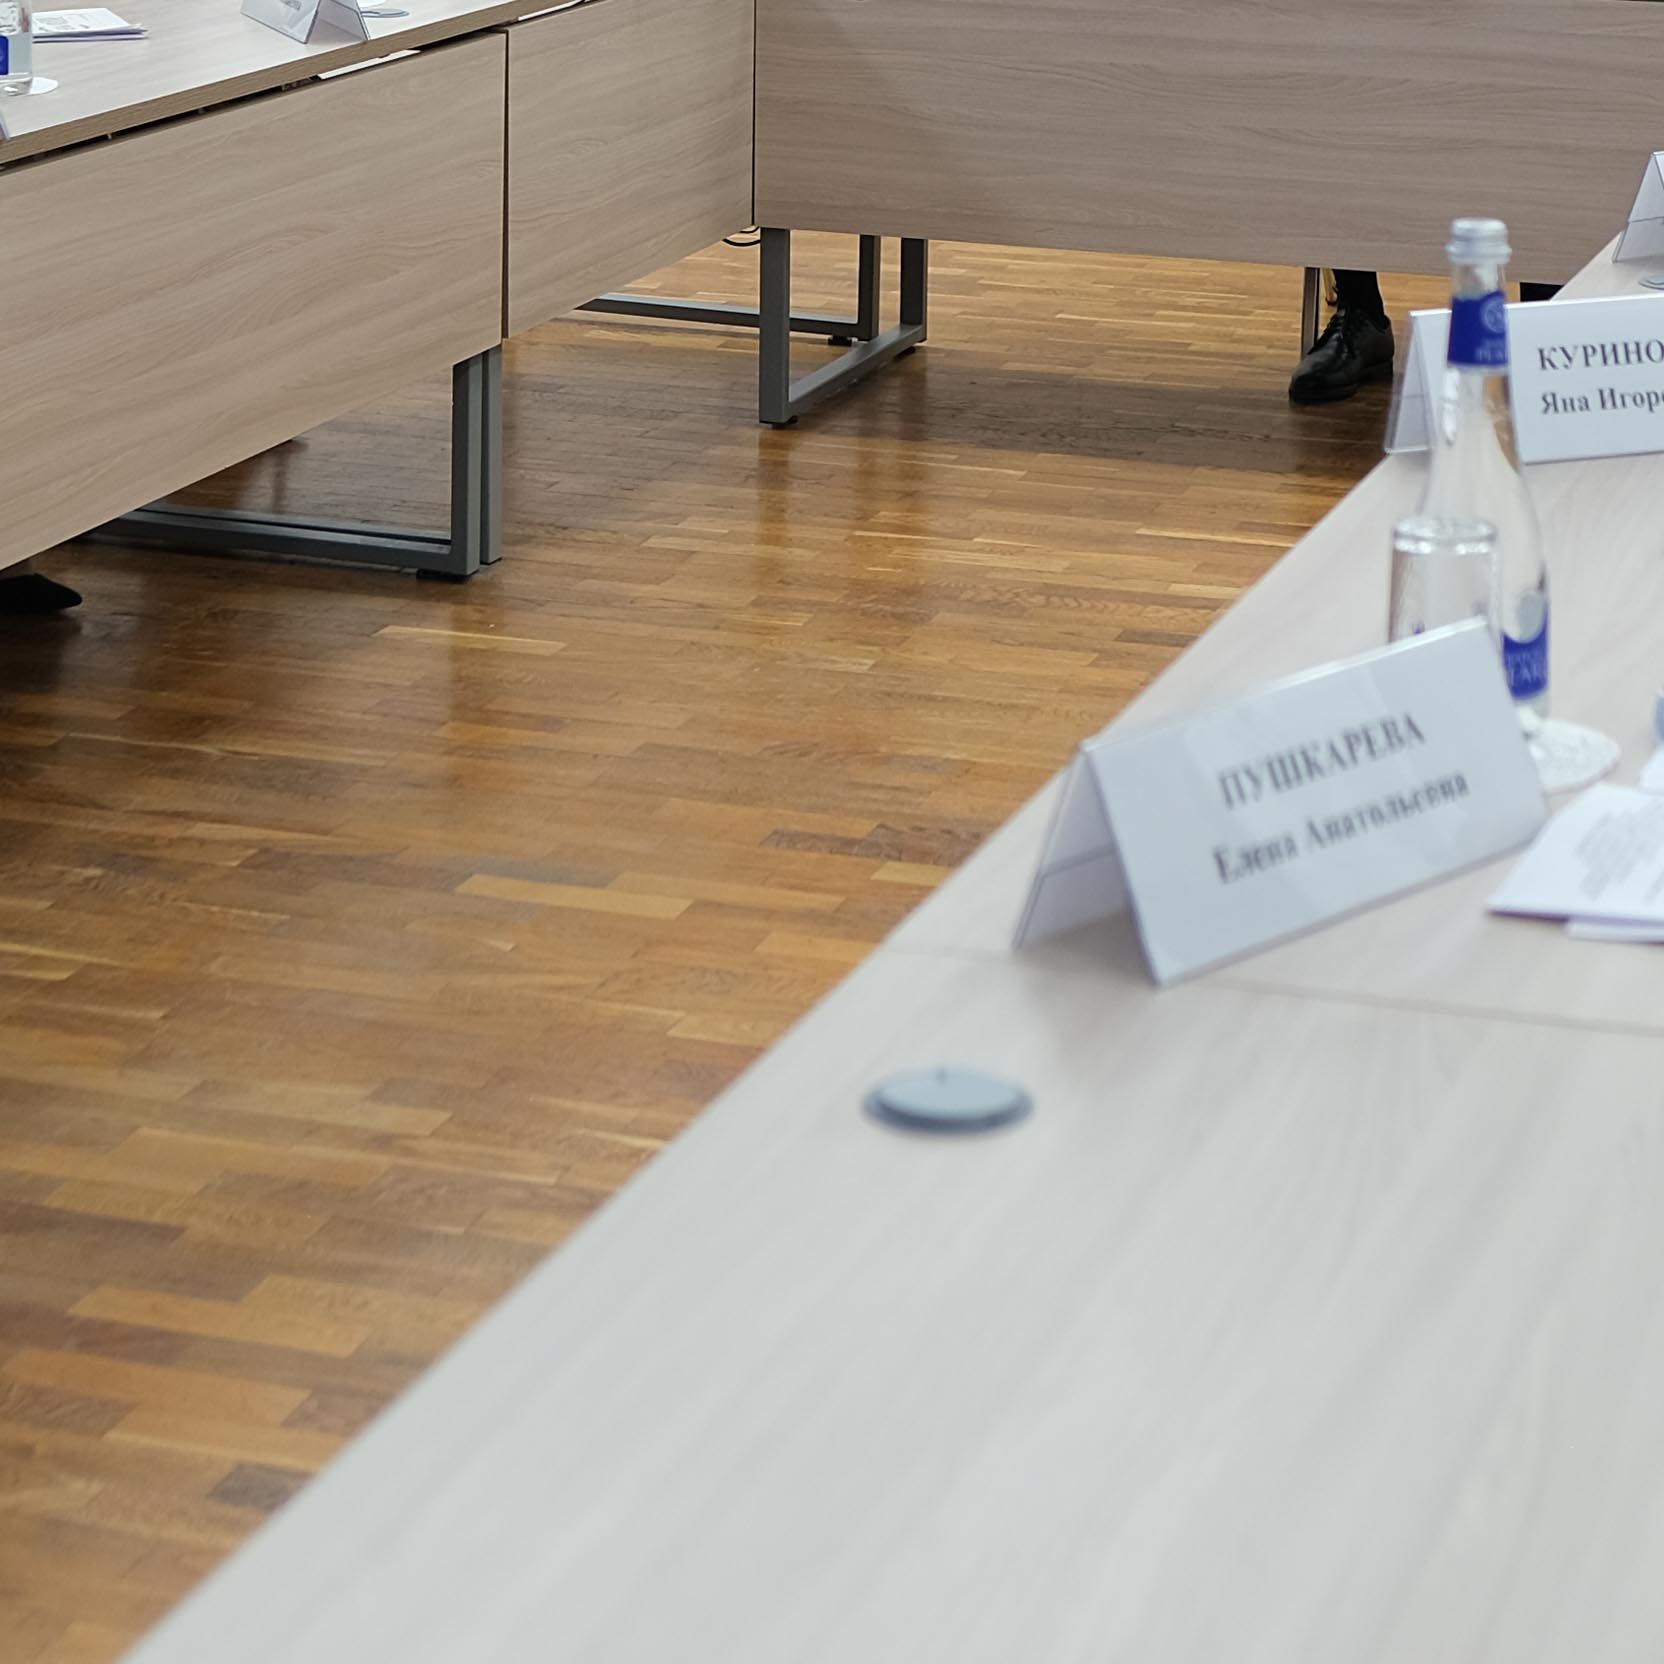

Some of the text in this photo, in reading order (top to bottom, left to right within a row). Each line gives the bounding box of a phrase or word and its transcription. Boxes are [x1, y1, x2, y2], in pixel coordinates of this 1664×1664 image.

[1541, 391, 1591, 415] Яна
[1218, 712, 1427, 810] ПУШКАРЕВА
[1213, 834, 1298, 884] Елена
